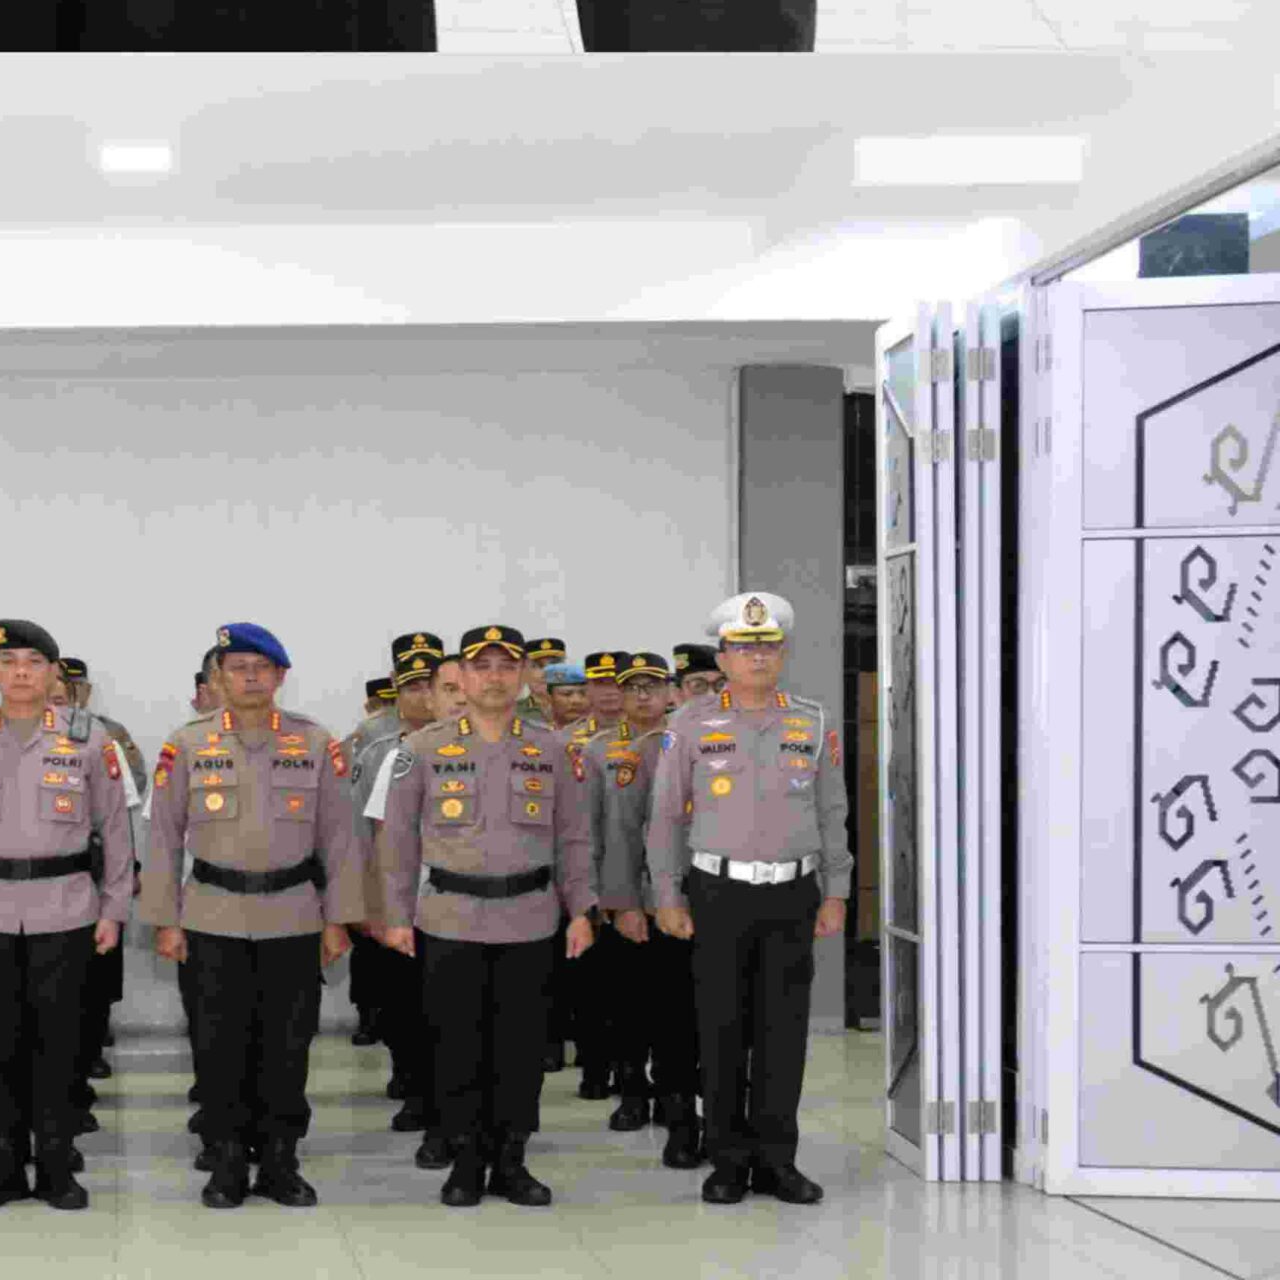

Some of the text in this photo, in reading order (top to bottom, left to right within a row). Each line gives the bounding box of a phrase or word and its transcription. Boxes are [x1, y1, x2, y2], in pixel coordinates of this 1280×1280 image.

[42, 757, 83, 768] POLRI
[193, 759, 234, 770] AGUS
[272, 759, 315, 770] POLRI
[510, 762, 553, 773] POLRI
